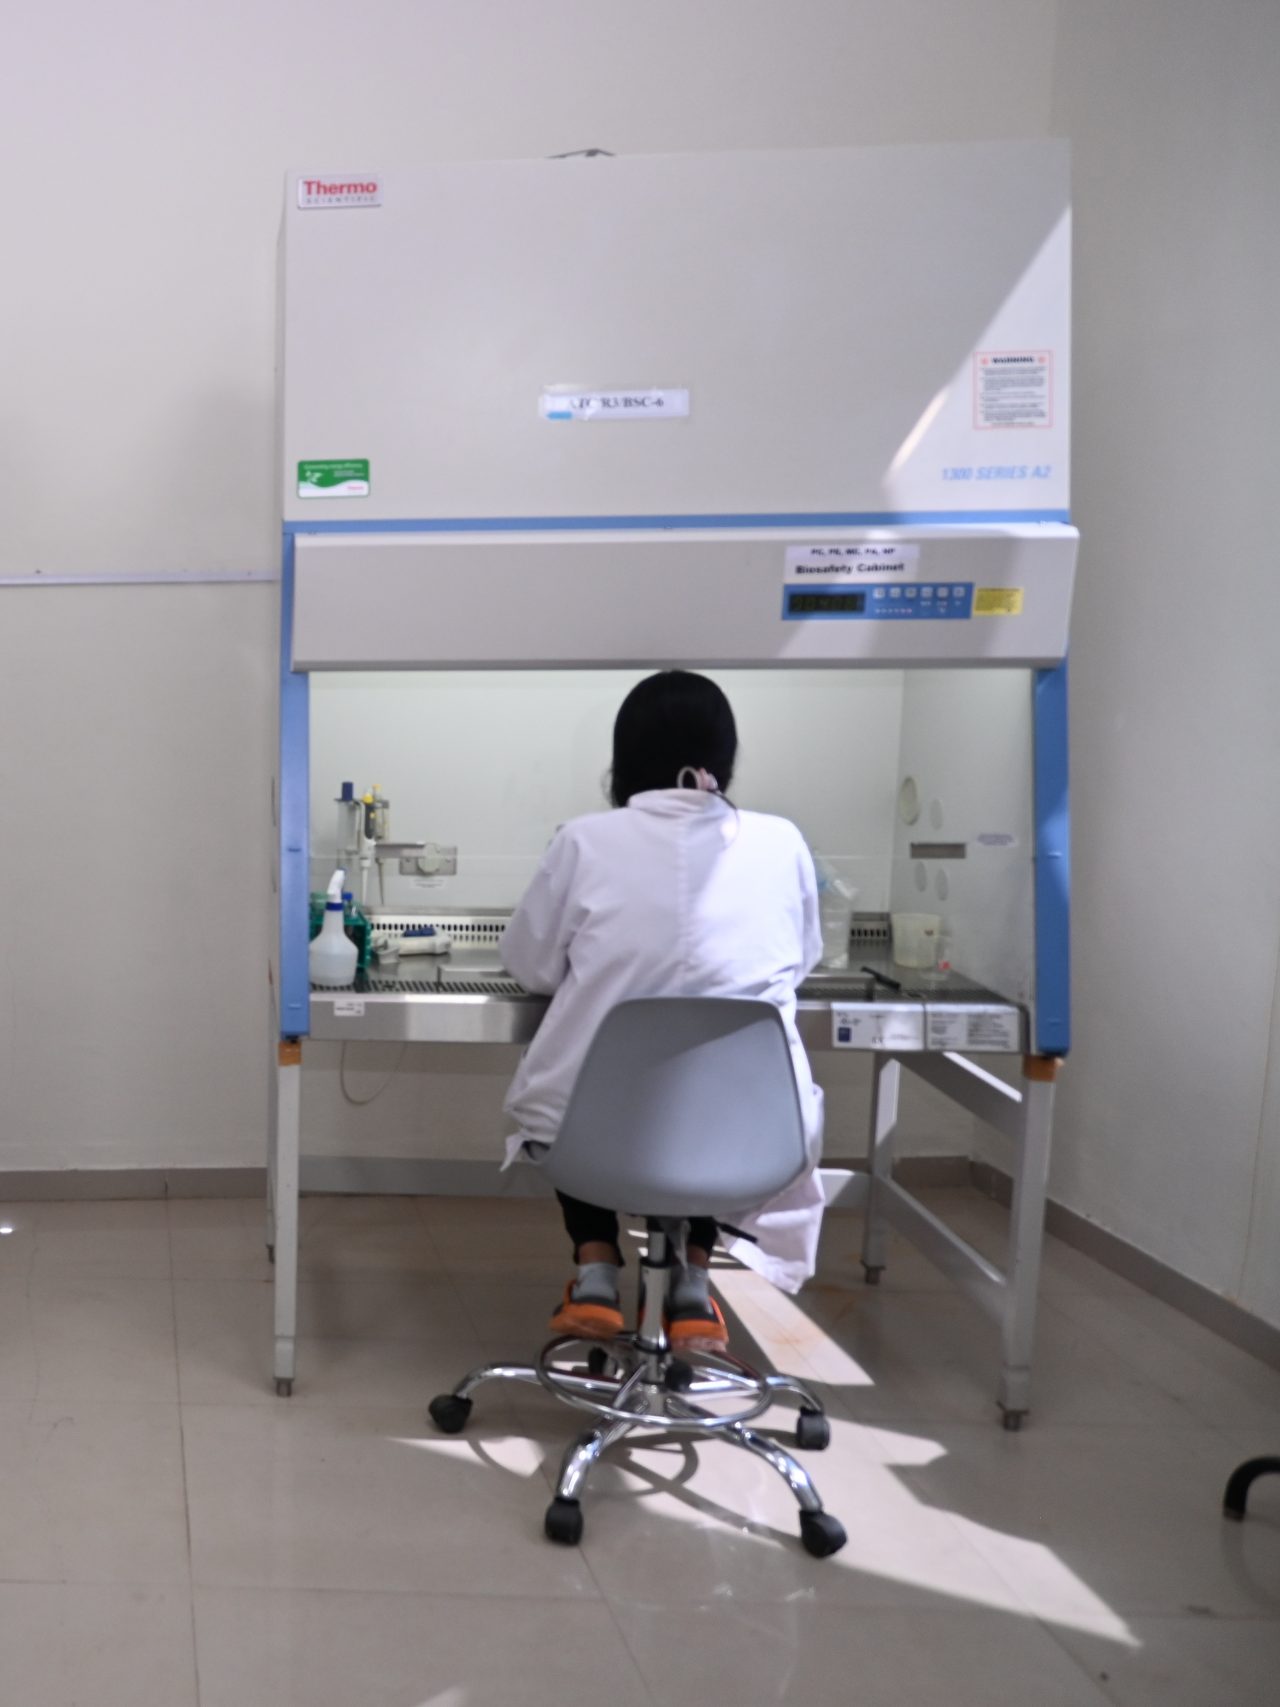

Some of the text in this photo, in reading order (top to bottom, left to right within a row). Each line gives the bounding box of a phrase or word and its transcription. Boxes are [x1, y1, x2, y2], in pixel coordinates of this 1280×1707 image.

[303, 180, 377, 195] Thermo
[796, 563, 904, 574] Biosafety Cabinet
